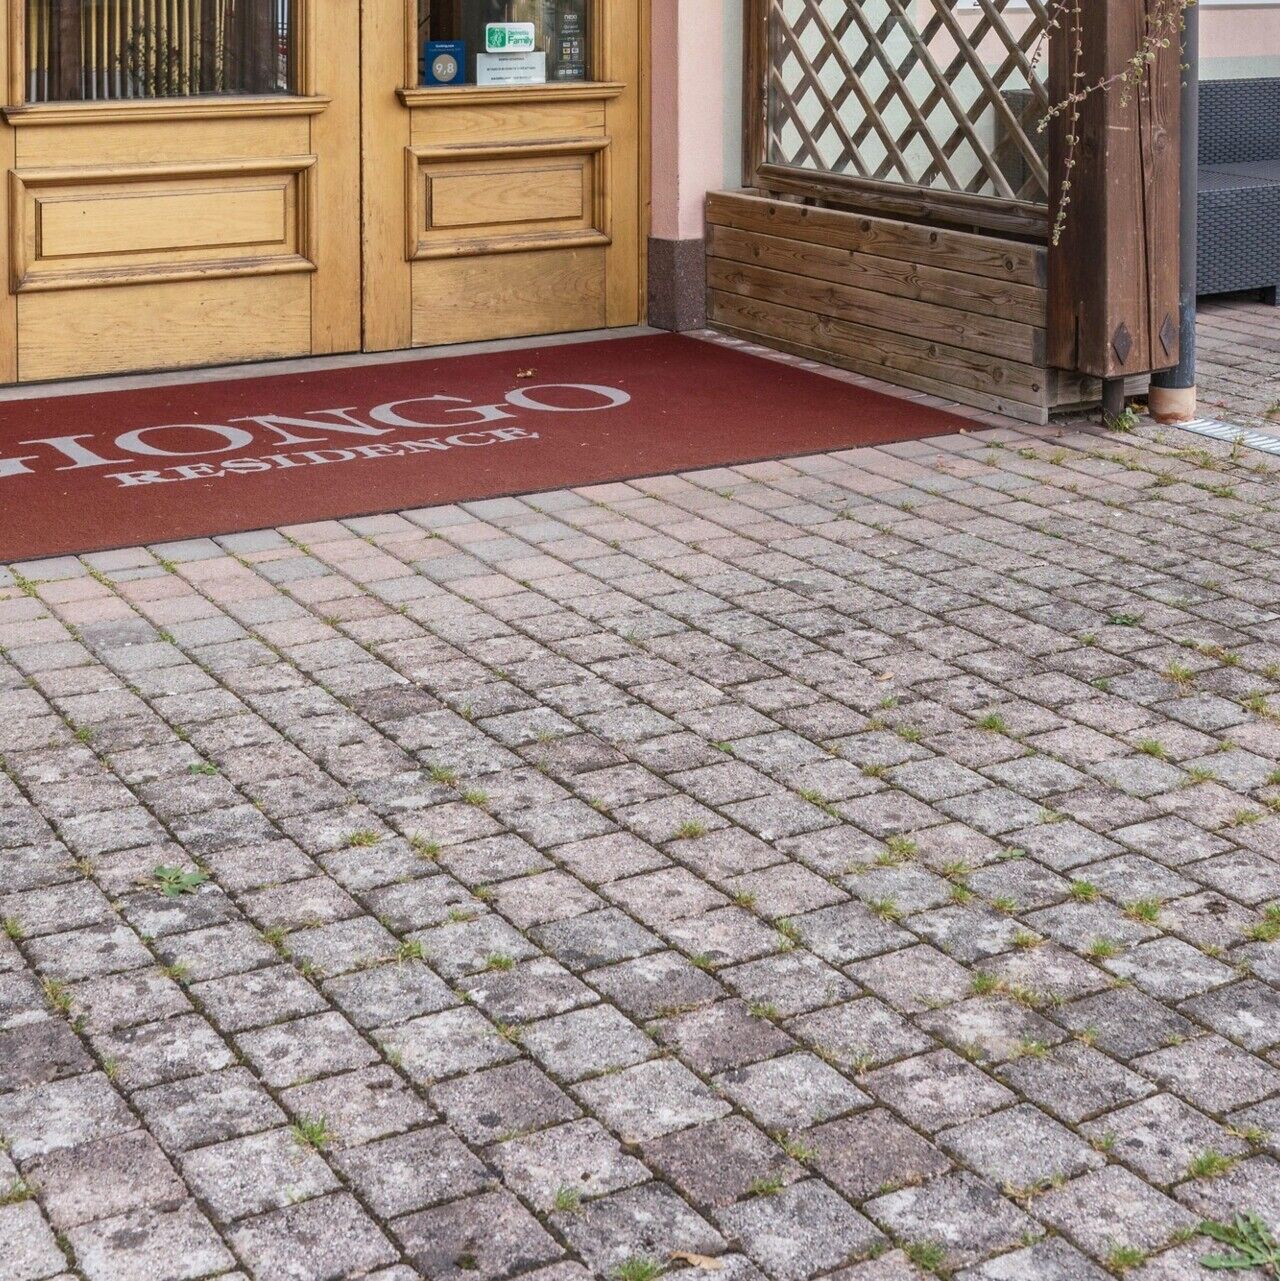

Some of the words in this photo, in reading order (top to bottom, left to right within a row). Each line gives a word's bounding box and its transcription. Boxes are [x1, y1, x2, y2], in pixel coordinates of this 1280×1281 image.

[508, 35, 534, 46] Family
[435, 63, 455, 76] 9,8
[116, 426, 540, 488] RESIDENCE
